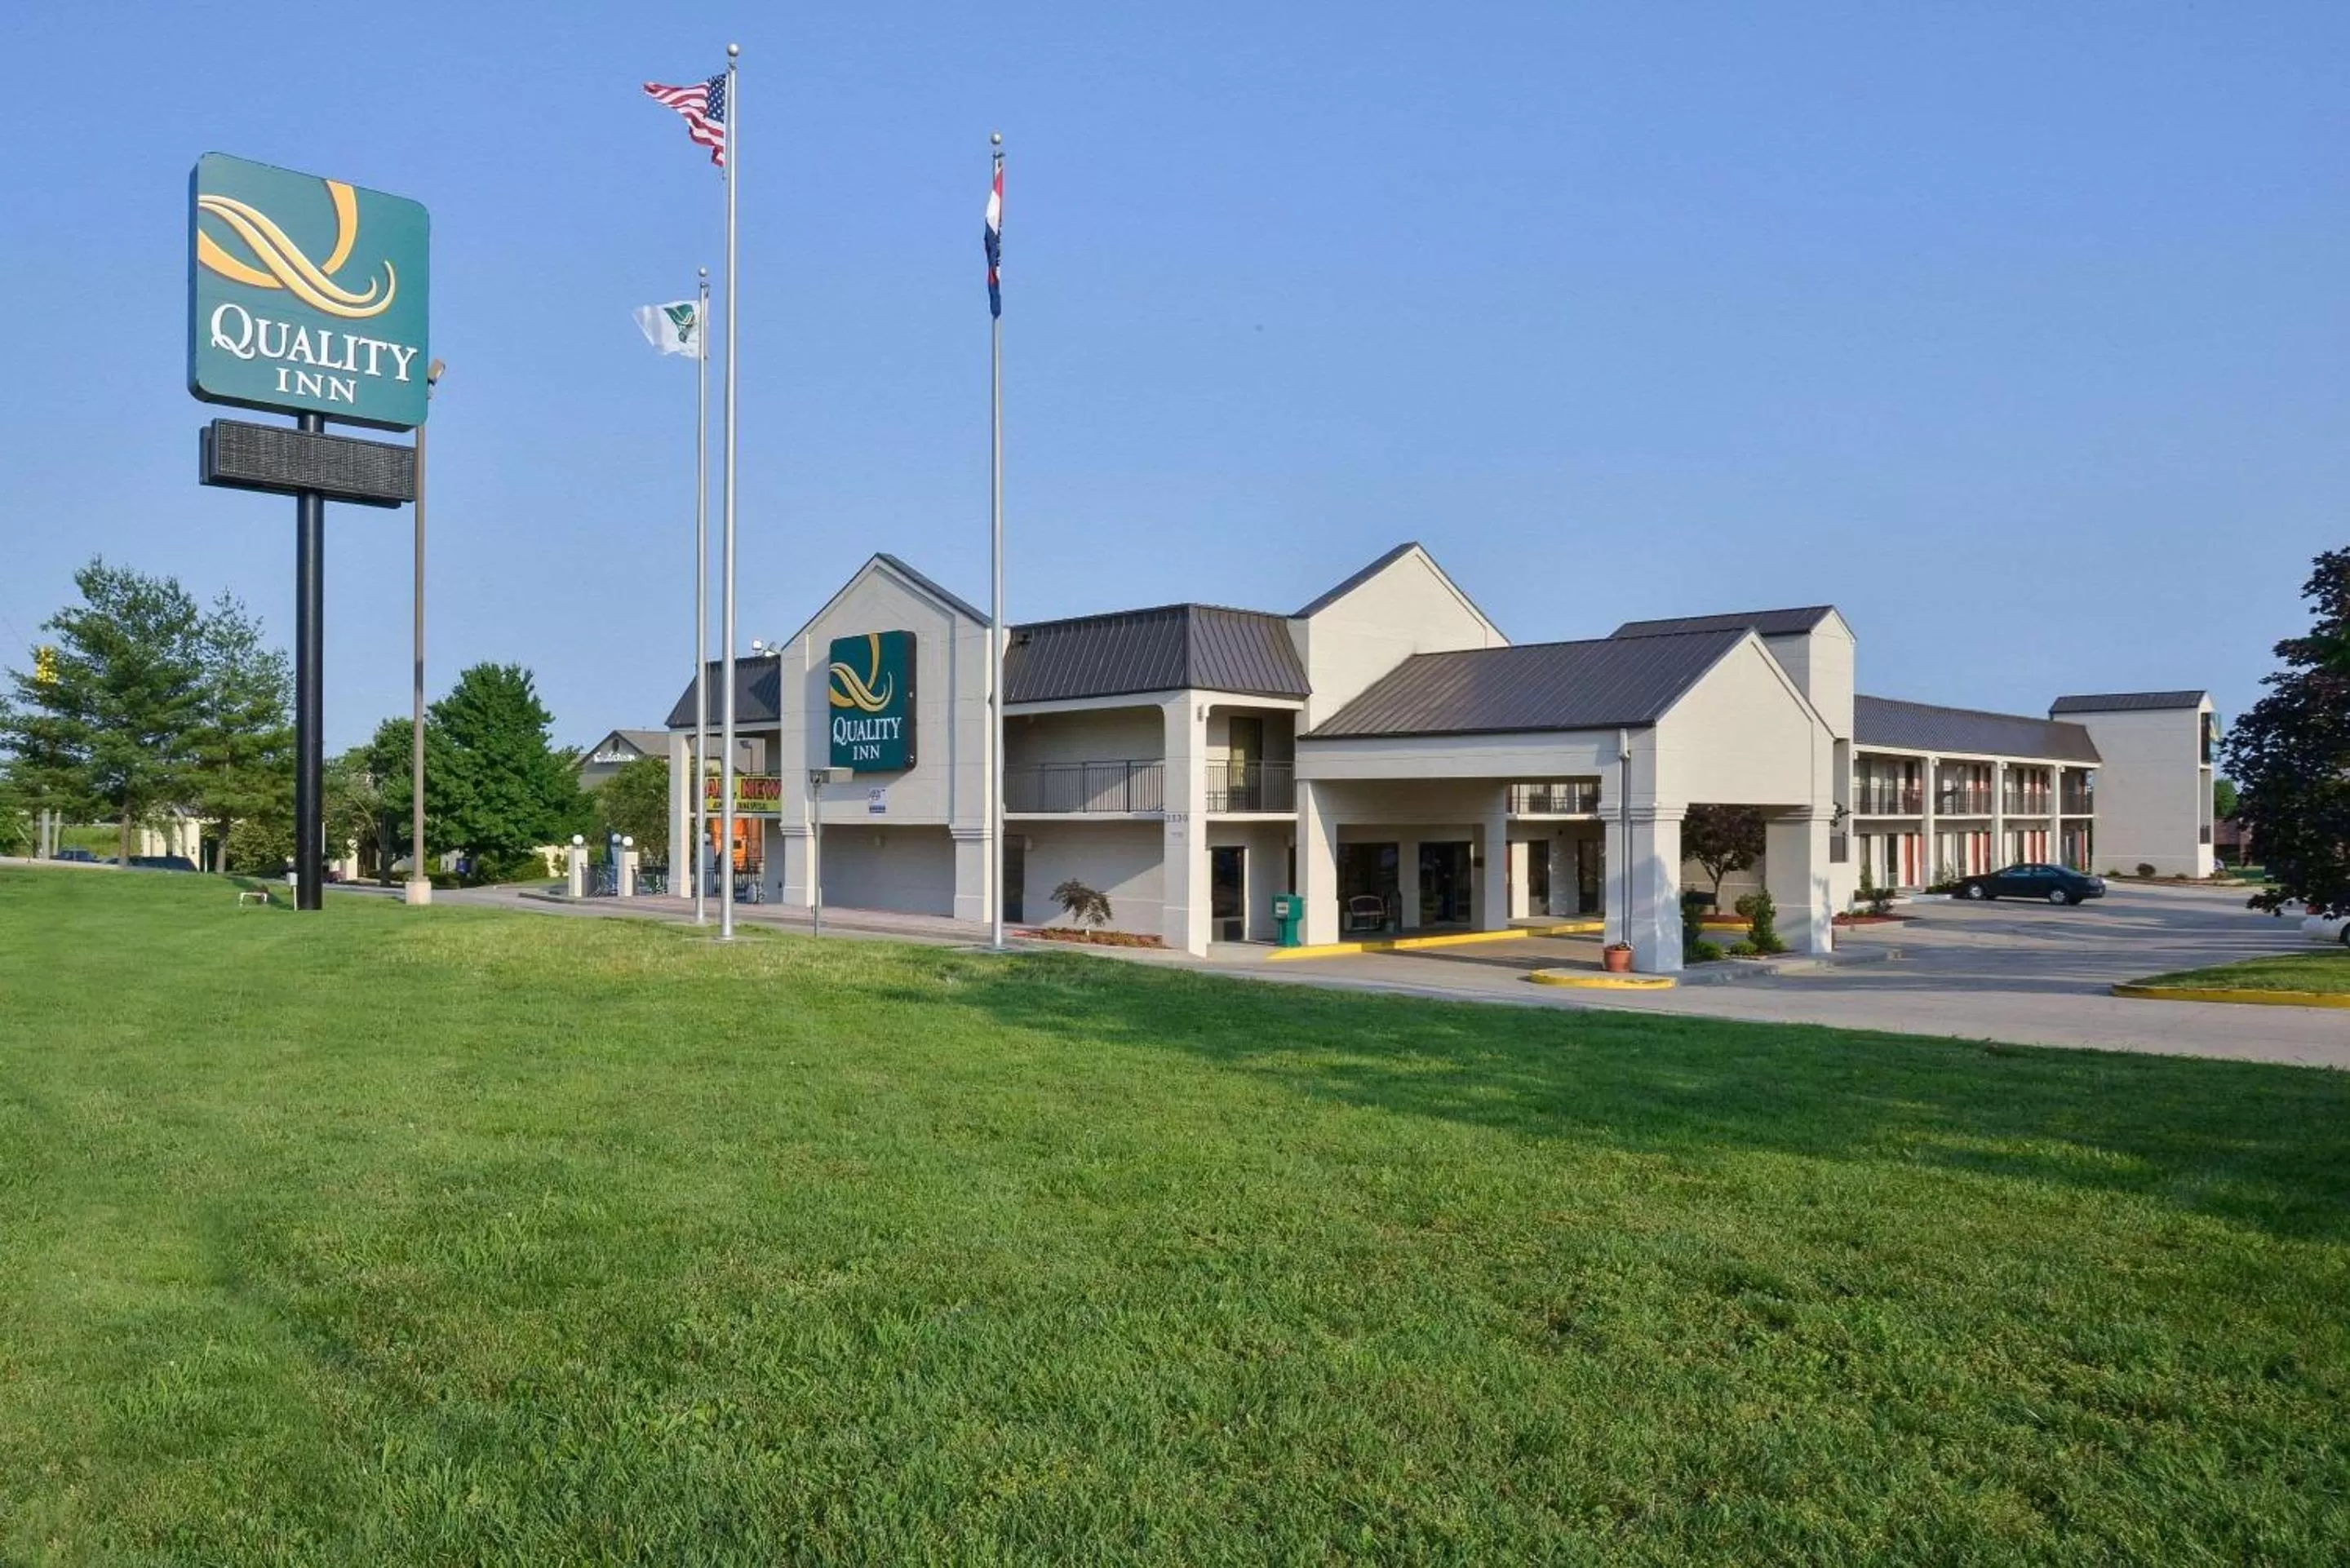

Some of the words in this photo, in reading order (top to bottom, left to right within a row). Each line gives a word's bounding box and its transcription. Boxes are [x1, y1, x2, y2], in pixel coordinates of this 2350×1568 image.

[211, 303, 418, 382] QUALITY
[275, 367, 357, 404] INN
[833, 716, 902, 746] QUALITY
[853, 744, 880, 760] INN
[740, 777, 783, 800] NEW
